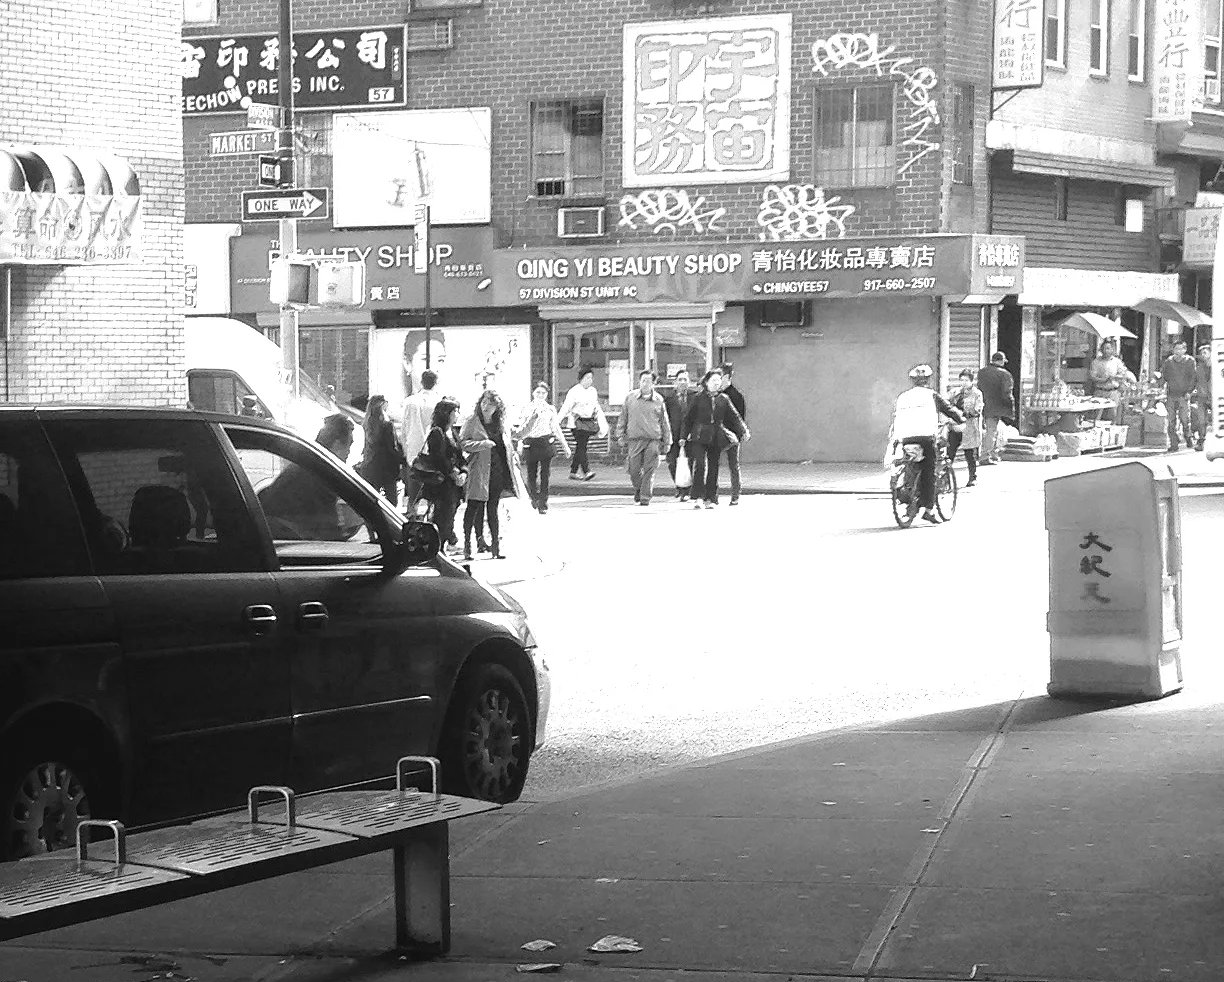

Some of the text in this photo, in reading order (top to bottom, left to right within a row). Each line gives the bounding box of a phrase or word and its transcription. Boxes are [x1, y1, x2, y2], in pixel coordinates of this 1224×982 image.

[246, 76, 301, 95] PRES
[310, 76, 345, 92] INC.
[372, 88, 390, 100] 57
[212, 133, 272, 153] MARKET ST
[254, 198, 314, 212] ONE WAY
[517, 253, 742, 279] QING YI BEAUTY SHOP
[519, 288, 532, 299] 57
[532, 287, 579, 299] DIVISION
[580, 286, 594, 298] ST
[595, 286, 621, 297] UNIT
[763, 277, 936, 294] CHINGYEE57 917-660-2507
